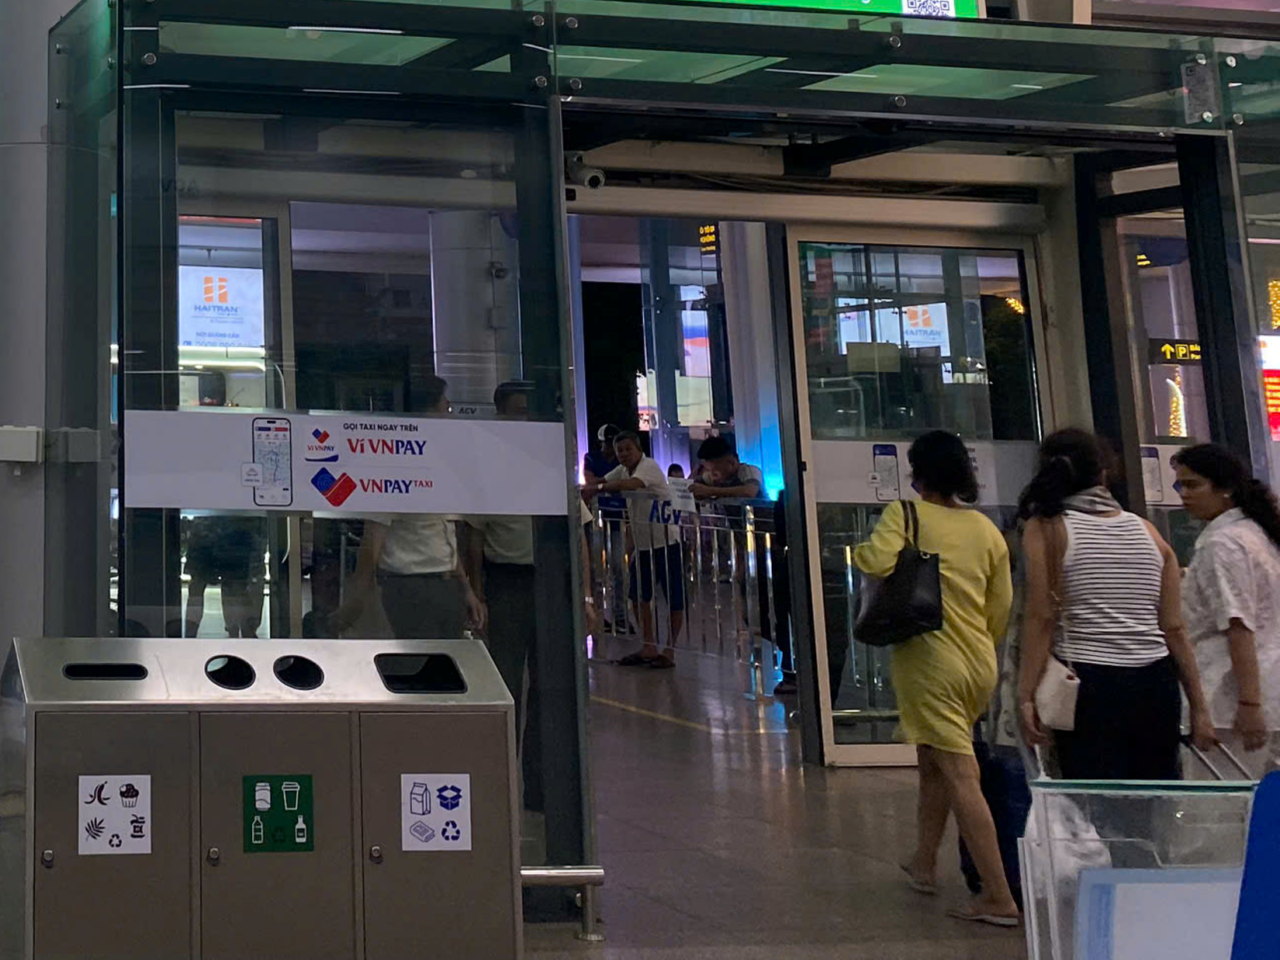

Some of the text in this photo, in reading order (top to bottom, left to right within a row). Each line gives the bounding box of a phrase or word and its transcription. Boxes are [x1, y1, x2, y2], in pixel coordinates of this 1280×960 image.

[359, 423, 376, 431] TAXI
[367, 439, 427, 455] VNPAY
[359, 479, 433, 494] VNPAY TAXI
